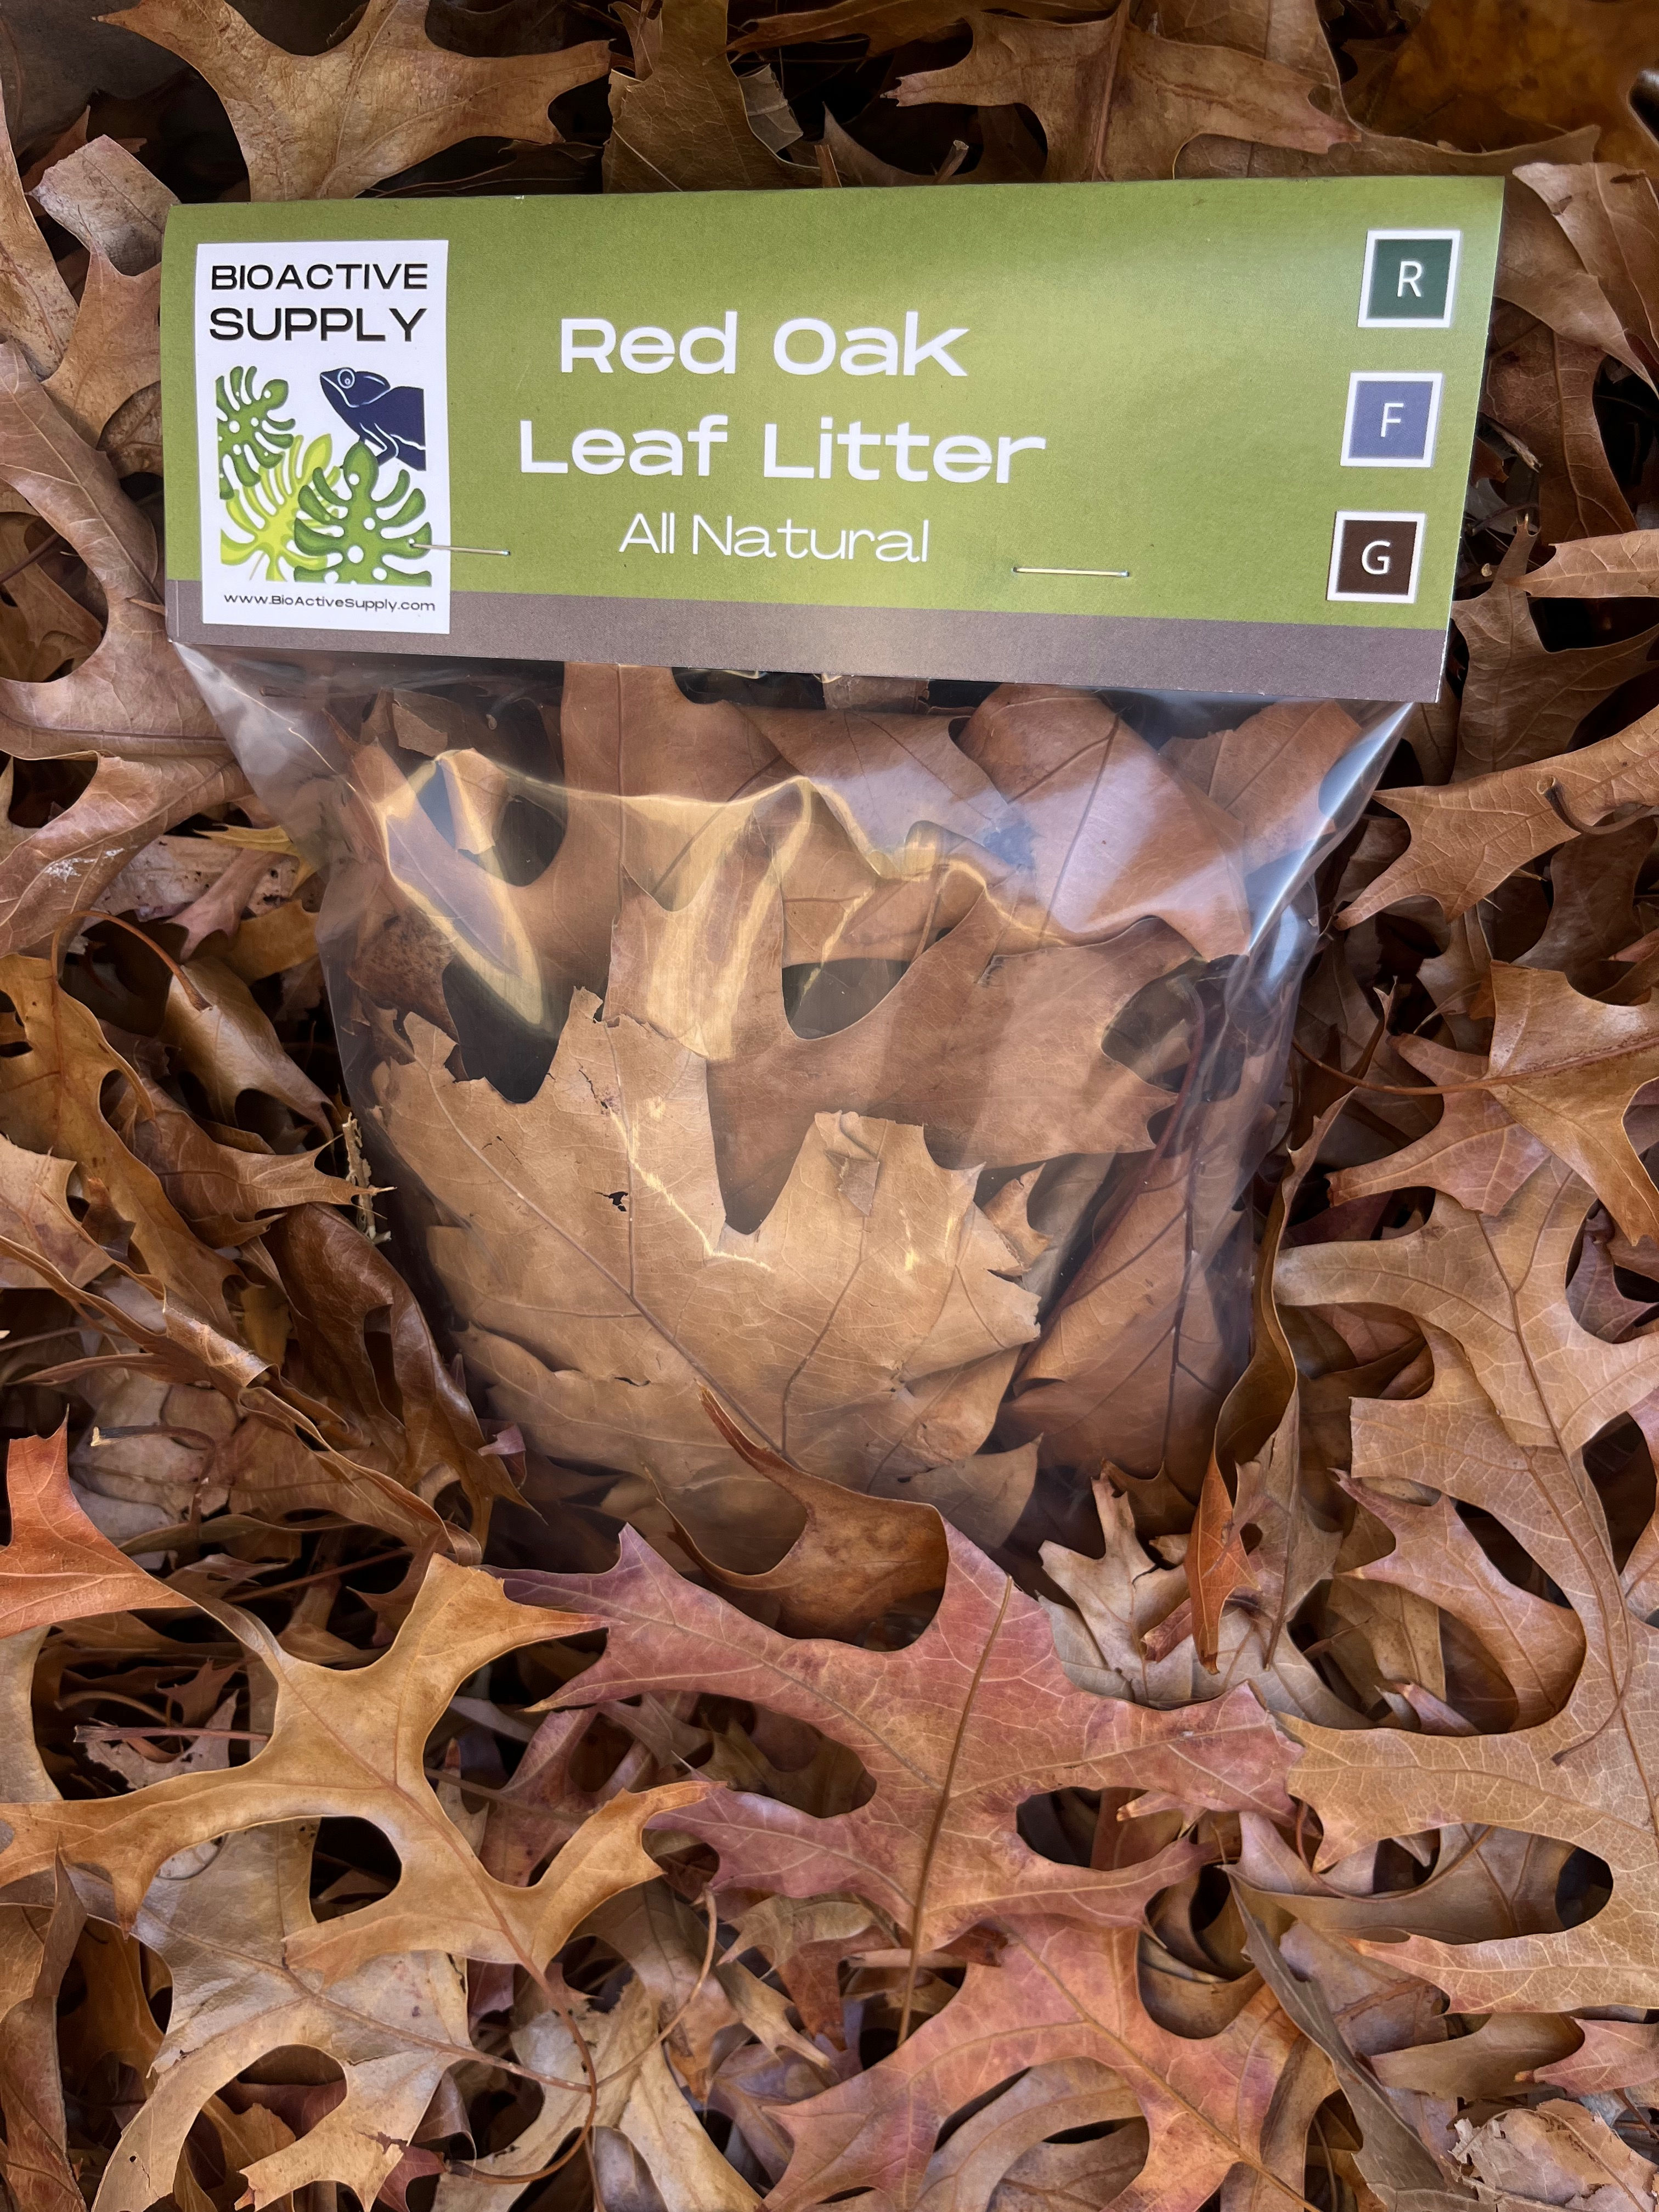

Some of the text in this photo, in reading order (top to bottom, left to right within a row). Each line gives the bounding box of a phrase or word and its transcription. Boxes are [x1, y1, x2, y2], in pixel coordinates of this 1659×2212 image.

[211, 263, 428, 290] BIOACTIVE
[1396, 260, 1425, 297] R
[209, 307, 428, 342] SUPPLY
[560, 311, 970, 377] Red Oak
[1380, 403, 1404, 438] F
[520, 414, 1046, 484] Leaf Litter
[618, 512, 930, 563] All Natural
[1361, 540, 1392, 575] G
[224, 594, 436, 612] www.BioActiveSupply.com
